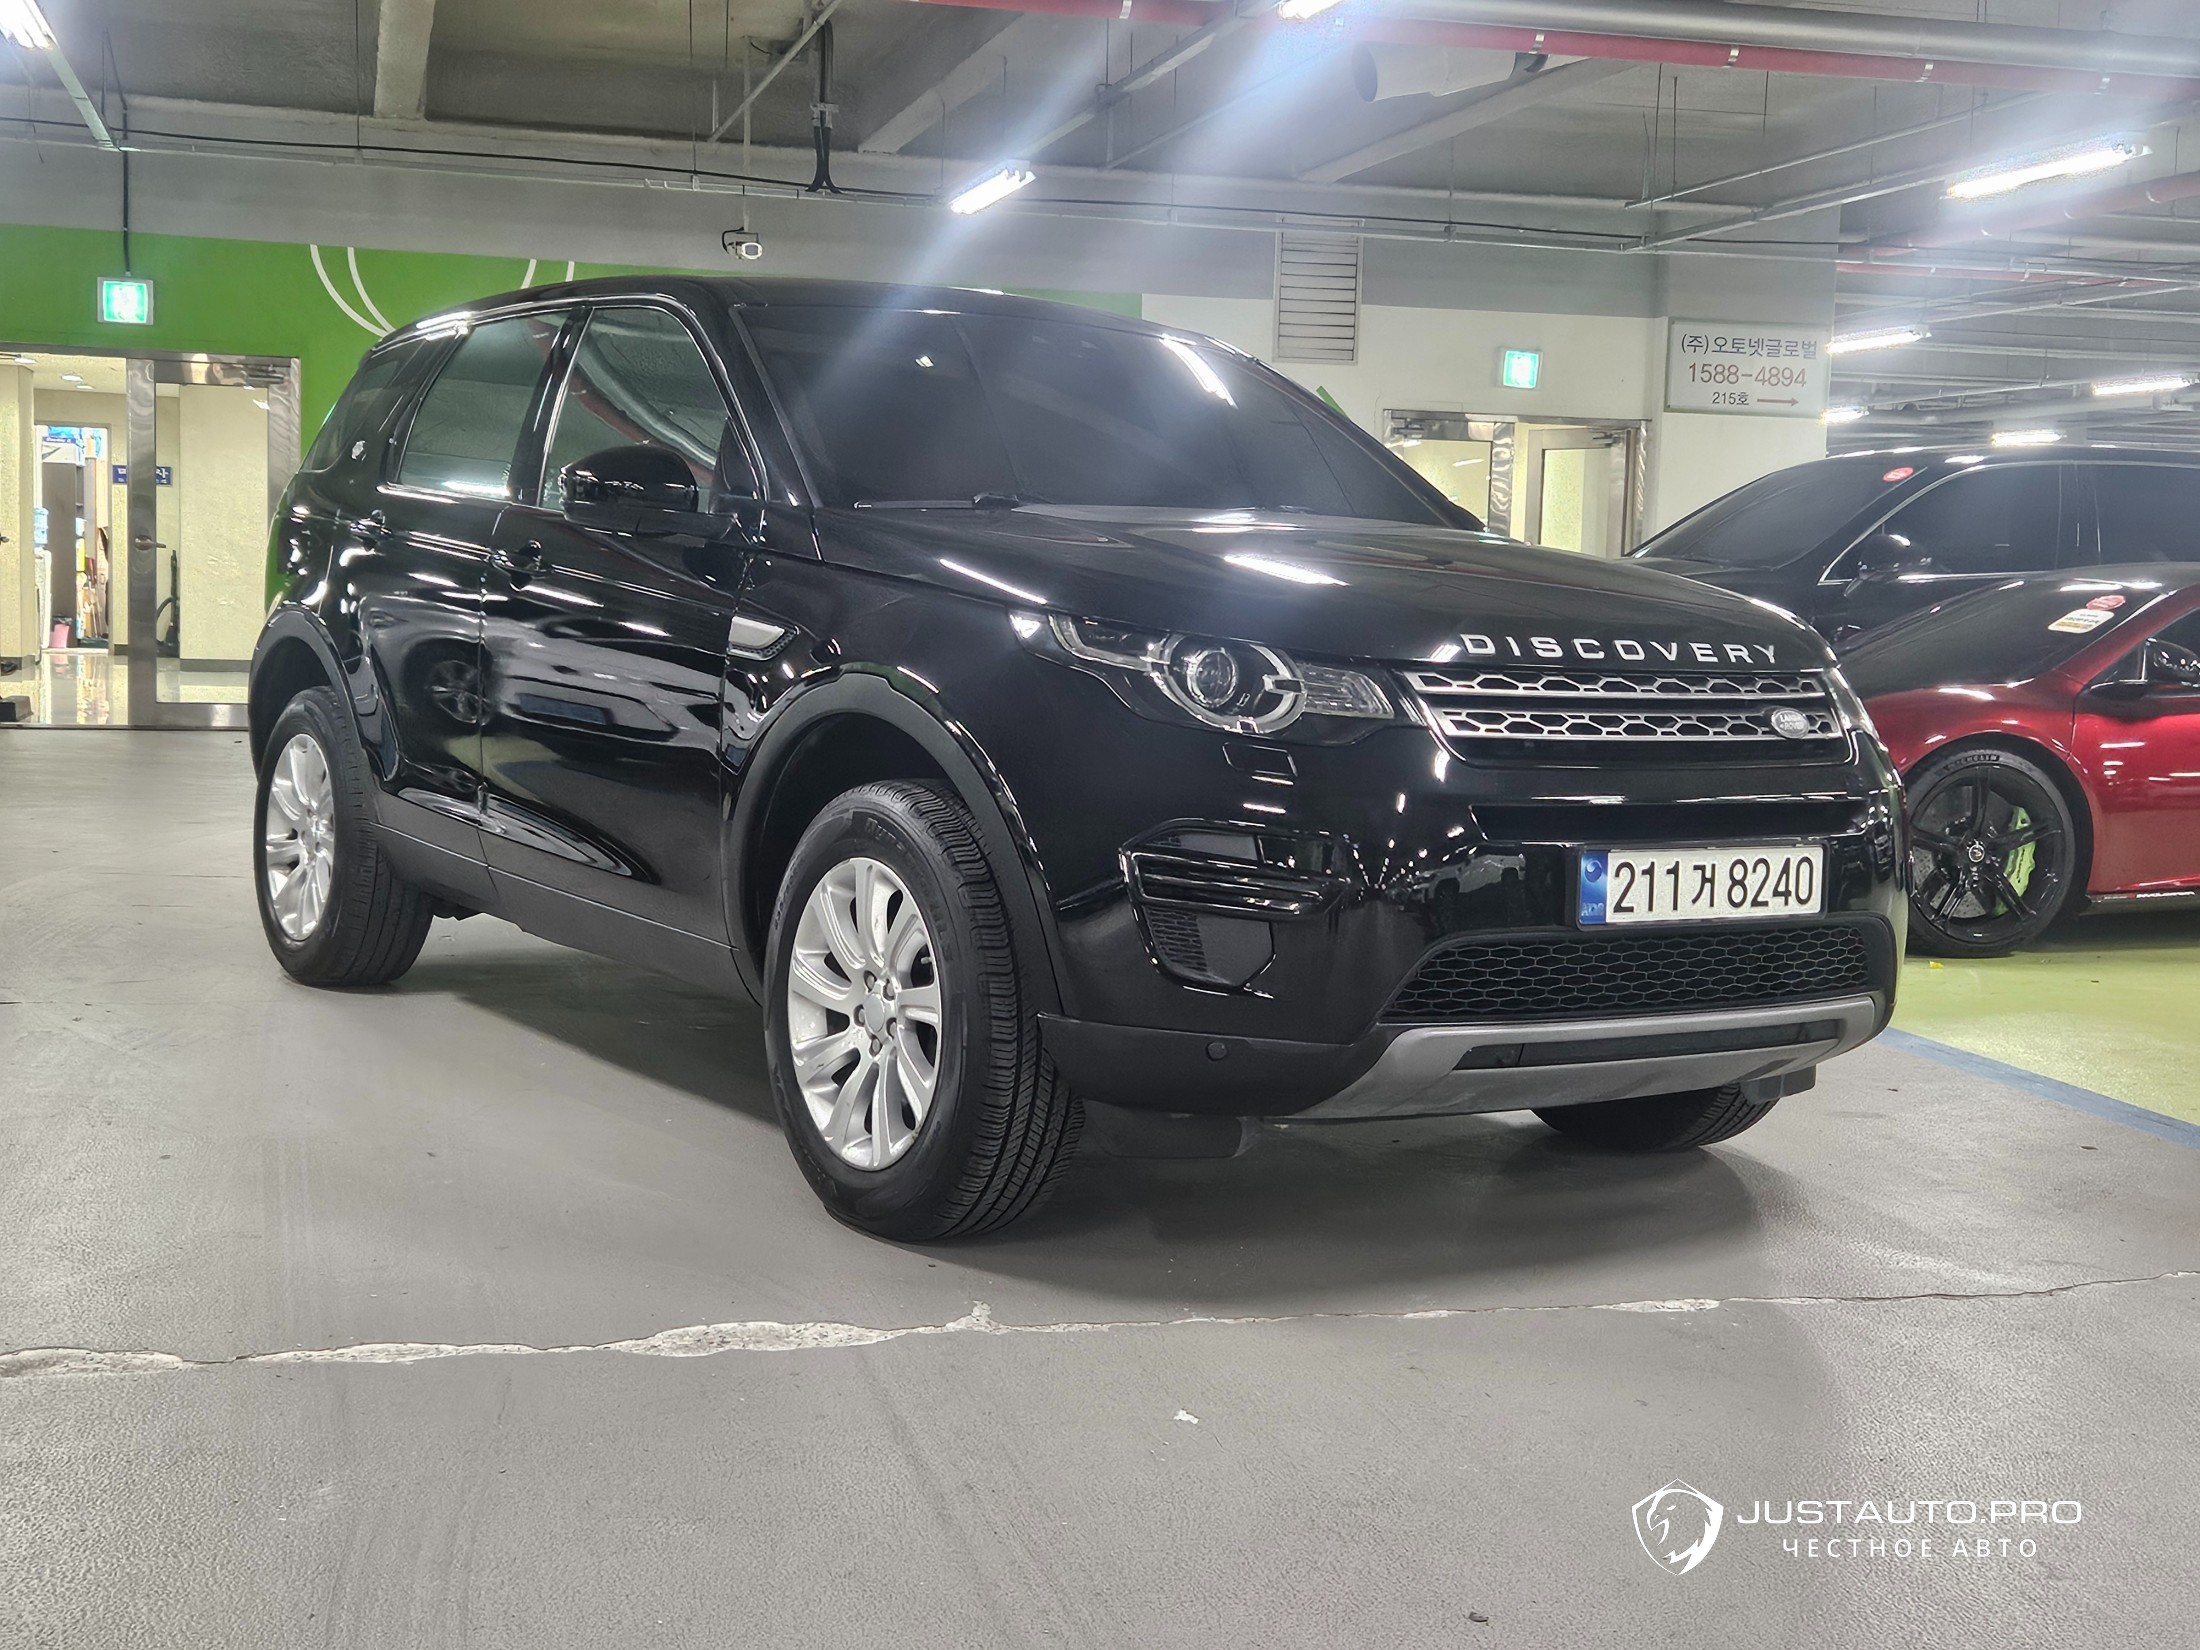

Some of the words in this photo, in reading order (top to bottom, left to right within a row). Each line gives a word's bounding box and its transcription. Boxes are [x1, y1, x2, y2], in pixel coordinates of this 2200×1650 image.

[1681, 333, 1817, 360] (주)오토넷글로벌
[1688, 362, 1808, 388] 1588-4894
[1711, 391, 1750, 406] 215호
[1459, 633, 1777, 665] DISCOVERY
